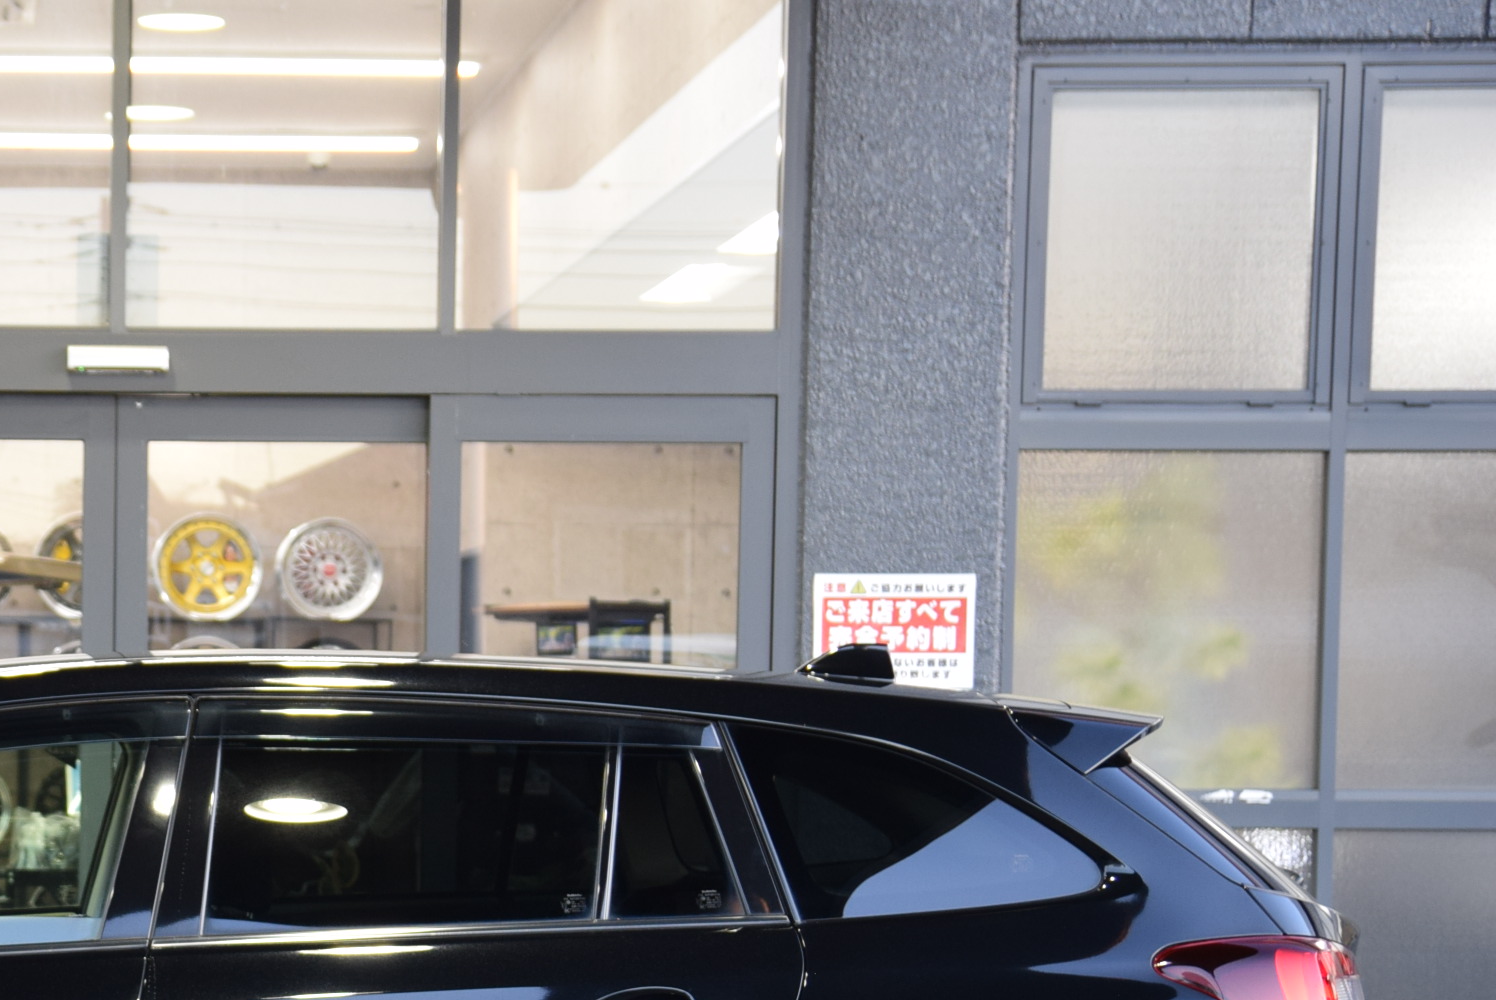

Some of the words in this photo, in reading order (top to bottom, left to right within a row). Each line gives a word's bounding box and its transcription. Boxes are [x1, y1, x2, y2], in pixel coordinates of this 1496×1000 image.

[824, 582, 846, 593] 注意
[870, 583, 966, 593] ご協力お願いします
[825, 598, 962, 624] ご来店すべて
[894, 670, 950, 679] り致します
